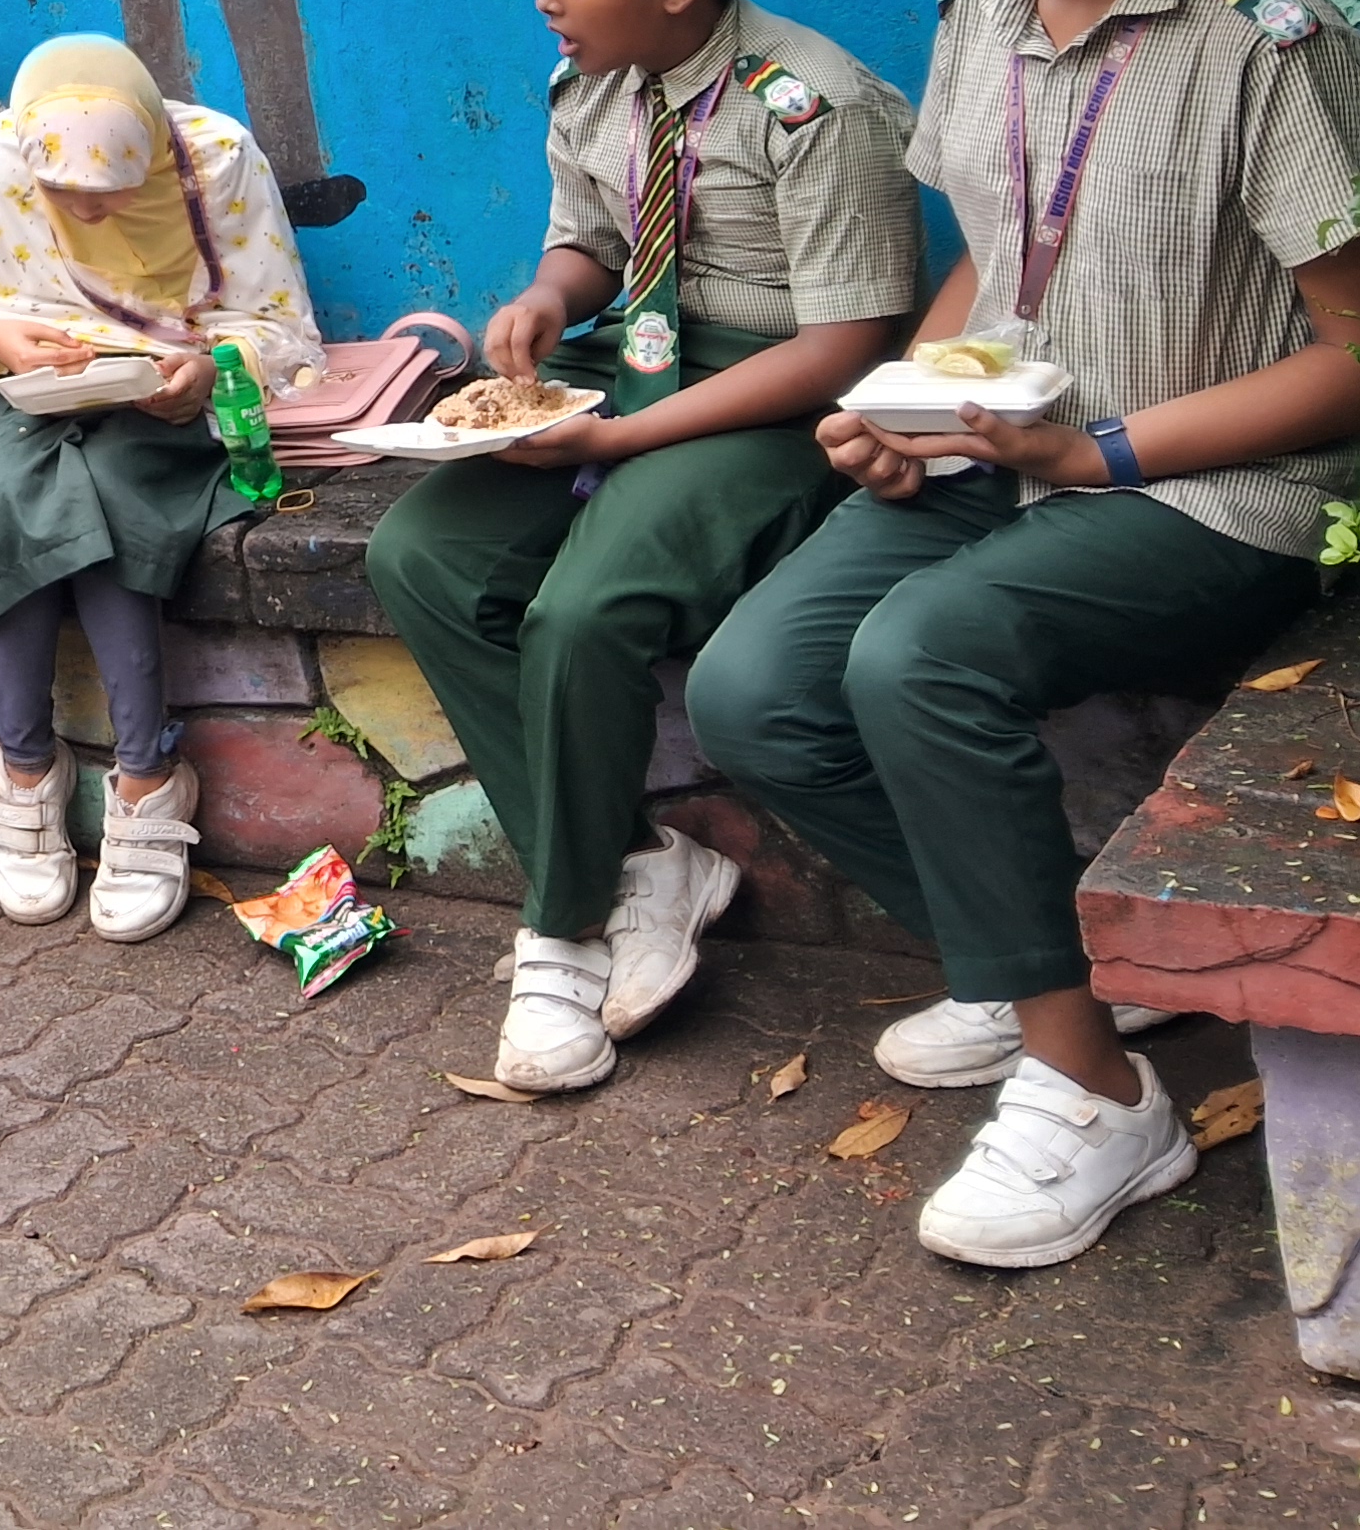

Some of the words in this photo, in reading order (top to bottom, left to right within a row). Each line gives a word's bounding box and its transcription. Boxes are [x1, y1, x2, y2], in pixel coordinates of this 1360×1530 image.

[1049, 170, 1077, 218] VISION
[1067, 125, 1093, 170] MODEL
[1084, 69, 1117, 123] SCHOOL
